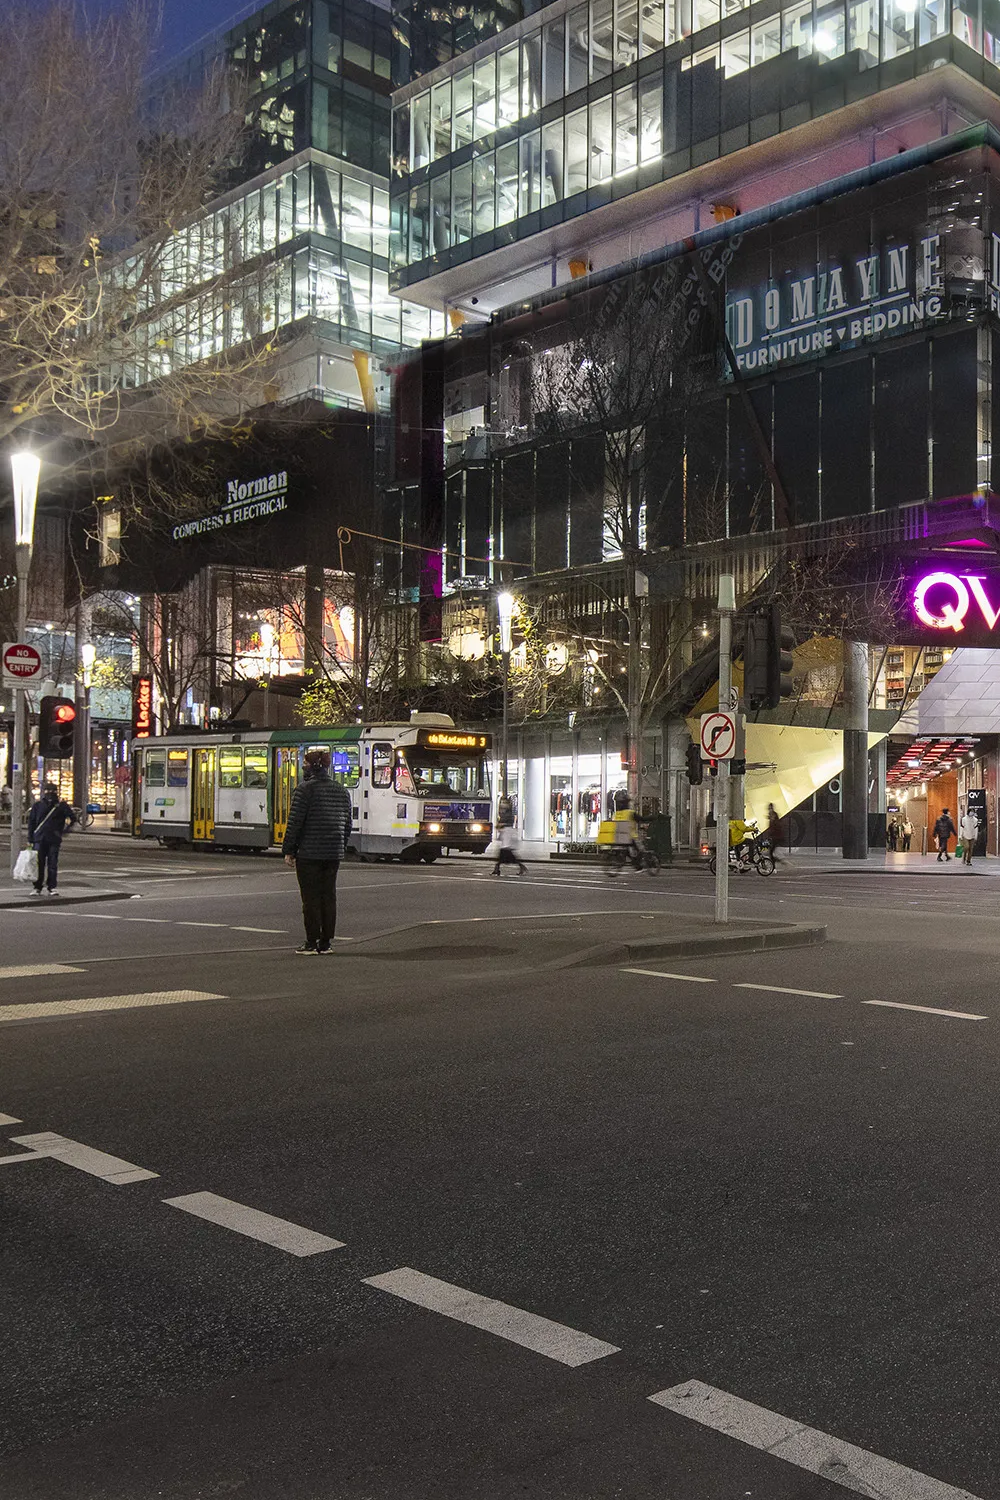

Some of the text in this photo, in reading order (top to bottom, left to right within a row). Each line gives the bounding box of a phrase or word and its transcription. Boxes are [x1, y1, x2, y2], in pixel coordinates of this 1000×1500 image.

[735, 234, 942, 349] DOMAYNE
[736, 296, 942, 370] FURNITURE BEDDING
[227, 470, 288, 504] Norman
[172, 514, 224, 540] COMPUTERS
[225, 512, 231, 525] &
[233, 496, 288, 523] ELECTRICAL
[9, 664, 36, 673] ENTRY
[16, 649, 29, 657] NO
[136, 678, 150, 728] Locker
[467, 736, 476, 746] Rd
[480, 737, 486, 747] 3
[968, 791, 980, 799] QV
